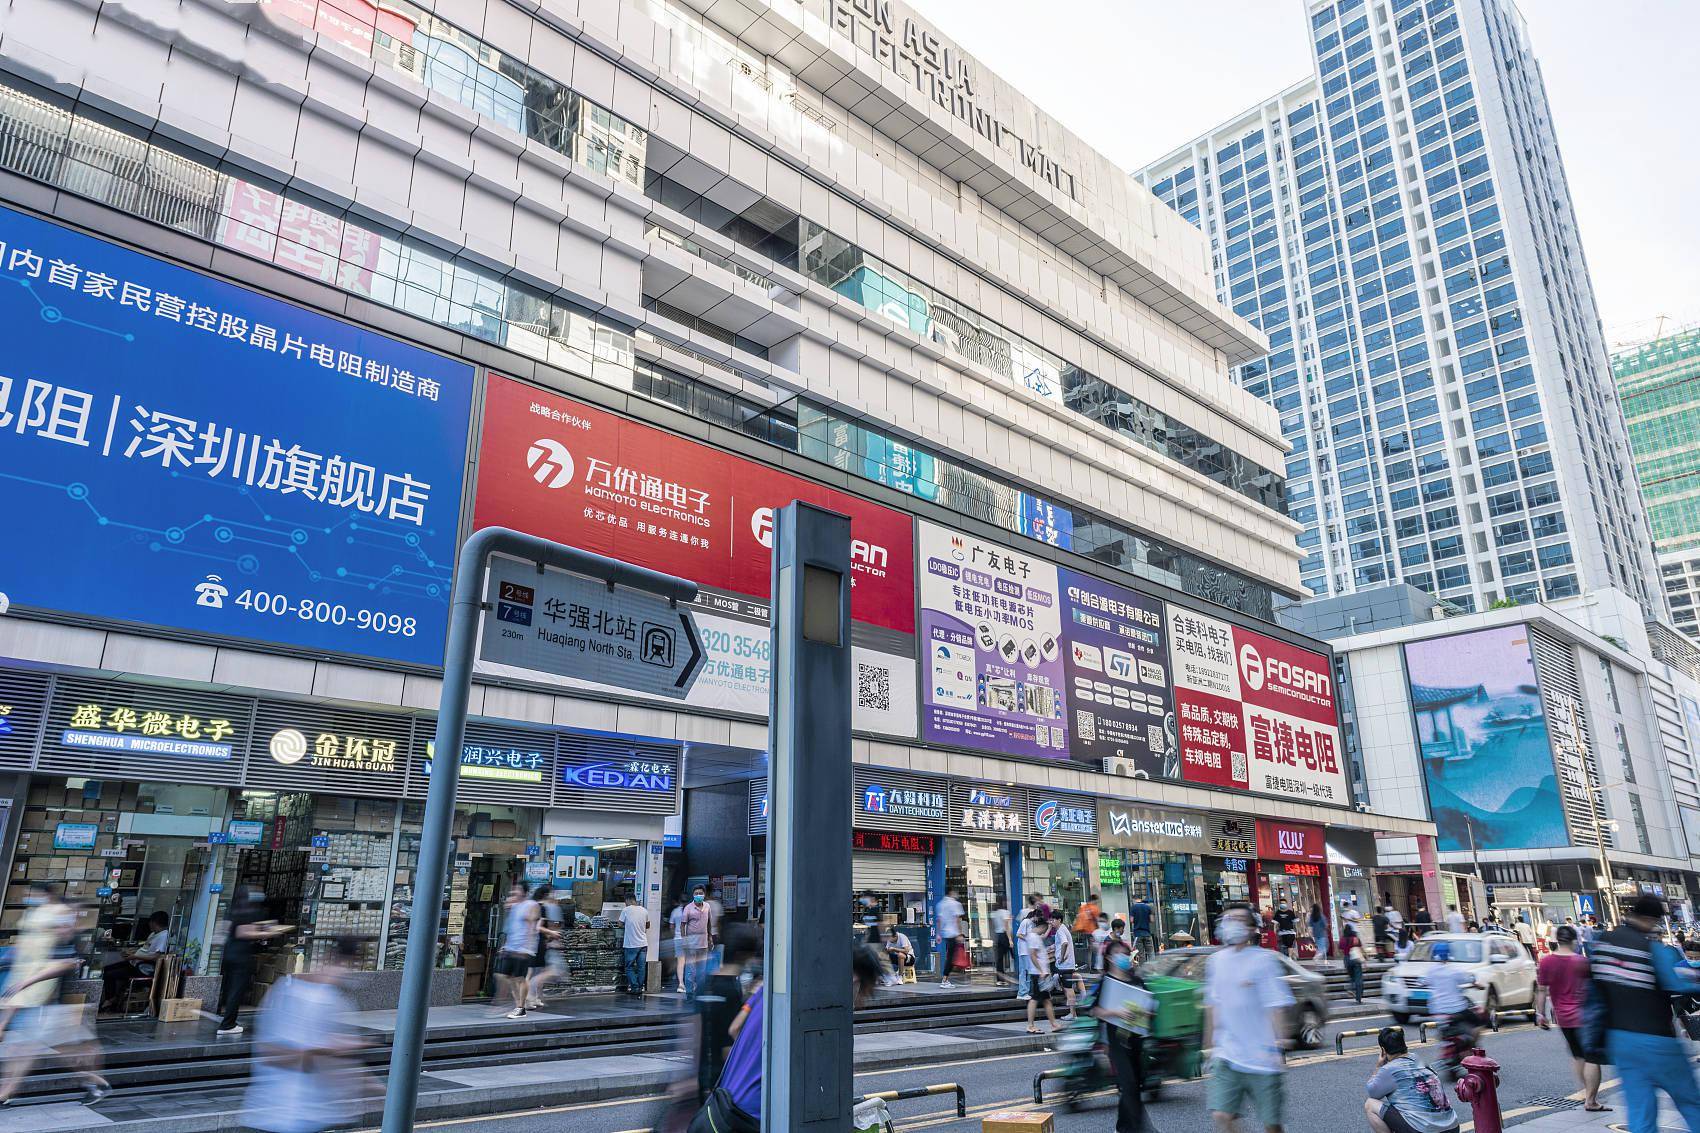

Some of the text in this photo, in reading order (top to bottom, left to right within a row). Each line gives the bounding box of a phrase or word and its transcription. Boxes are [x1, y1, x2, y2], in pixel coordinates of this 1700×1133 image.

[903, 17, 974, 97] ASIA
[529, 401, 592, 431] 战略合作伙伴
[124, 404, 431, 526] 深圳旗舰店
[585, 456, 711, 514] 万优通电子
[583, 507, 710, 549] 优芯优品 用服务连通你我
[851, 539, 888, 568] AN
[971, 545, 1031, 579] 广友电子
[851, 562, 886, 578] UCTOR
[235, 589, 417, 637] 400-800-9098
[747, 605, 769, 618] 二极管
[952, 584, 1035, 618] 专注低功耗电源芯片
[954, 599, 1034, 631] 低电压小功率MOS
[543, 597, 637, 642] 华强北站
[1173, 613, 1230, 647] 合美科电子
[502, 629, 524, 641] 230m
[537, 627, 635, 661] Huaqiang North Sta.
[700, 628, 731, 653] 320
[703, 659, 770, 683] 万优通电子
[1266, 657, 1331, 697] FOSAN
[70, 704, 235, 742] 盛华微电子
[66, 733, 229, 758] SHENGHUA MICROELECTRONICS
[313, 733, 396, 763] 金环冠
[463, 746, 544, 770] 润兴电子
[1185, 748, 1222, 769] 车规电阻
[1250, 713, 1339, 775] 富捷电阻
[310, 756, 395, 772] JIN HUAN GUAN
[565, 764, 671, 790] KEDIAN
[1264, 774, 1333, 800] 富捷电阻深圳一级代理
[1278, 830, 1303, 850] KUU
